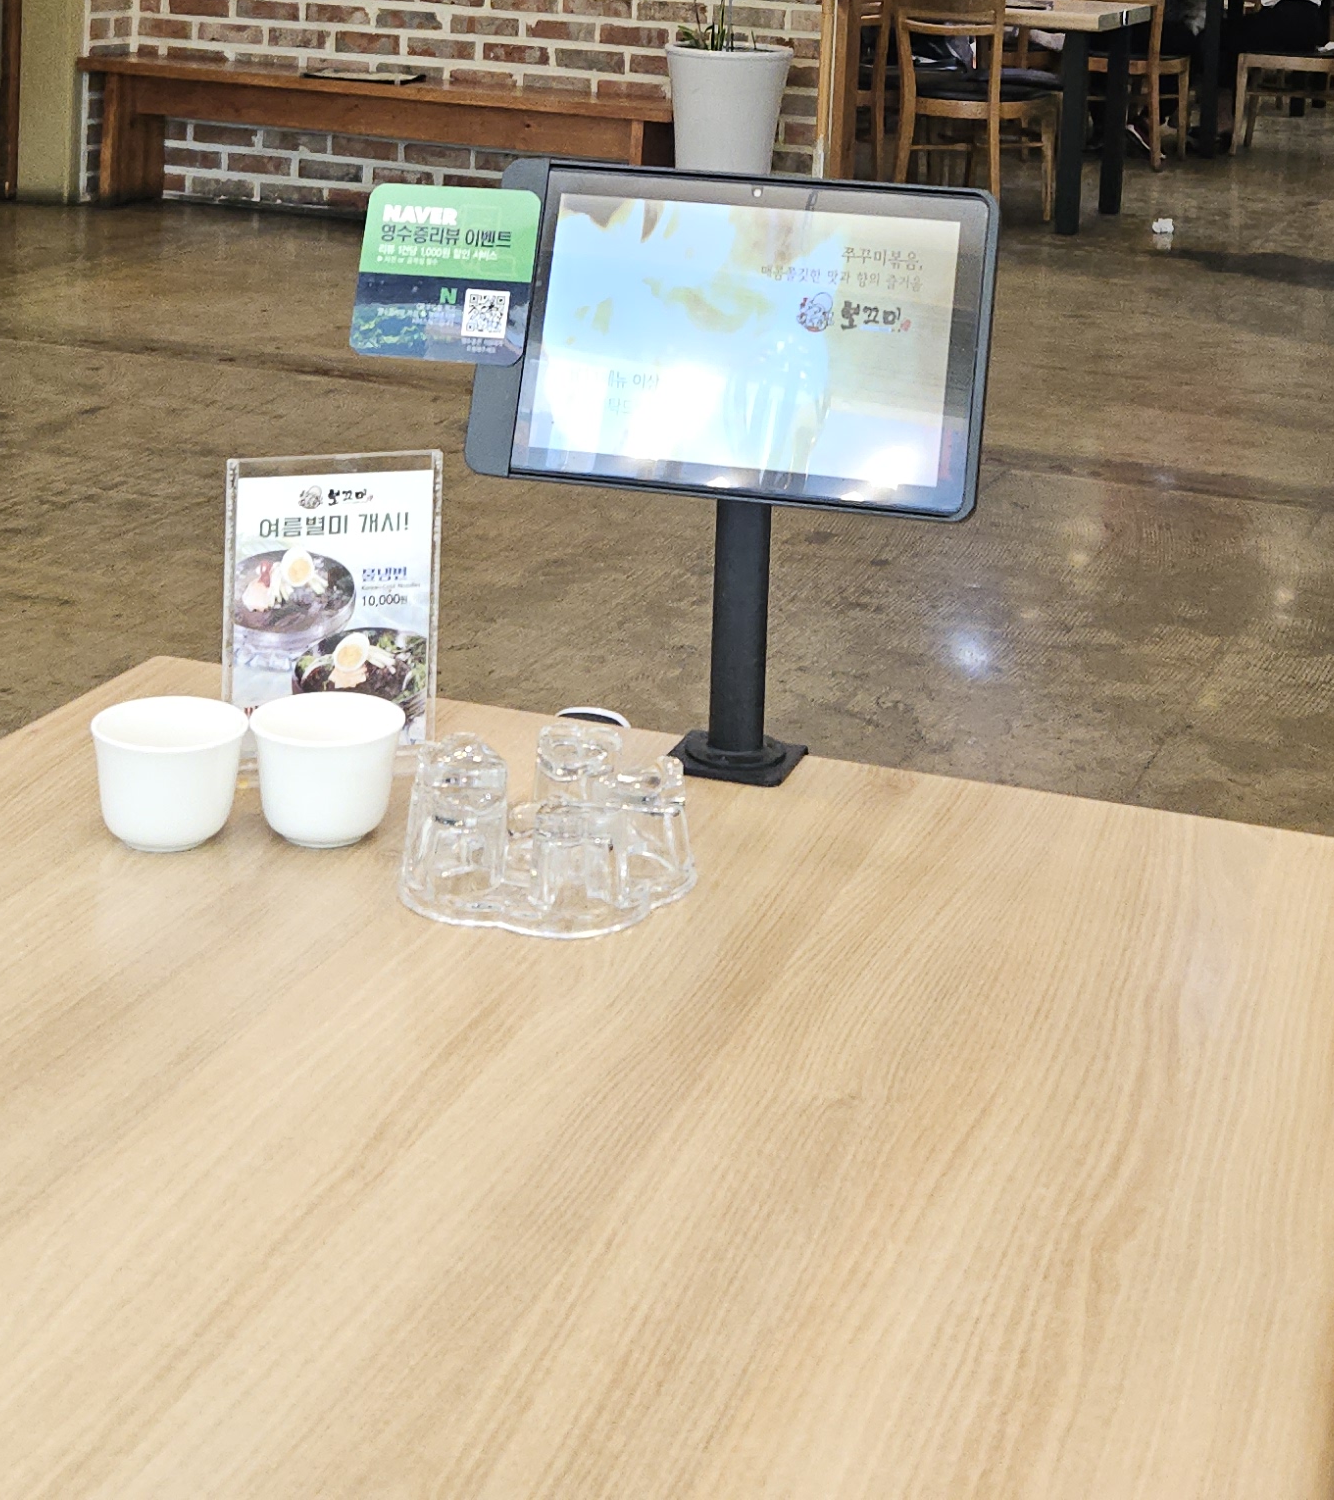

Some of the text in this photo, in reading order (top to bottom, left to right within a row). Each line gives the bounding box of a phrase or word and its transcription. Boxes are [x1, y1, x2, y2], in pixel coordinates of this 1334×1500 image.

[382, 203, 458, 226] NAVER
[380, 223, 513, 249] 영수증리뷰 이벤트
[827, 269, 851, 286] 맛과
[439, 287, 459, 305] N
[259, 511, 409, 539] 여름별미 개시!
[362, 593, 408, 607] 10,000원
